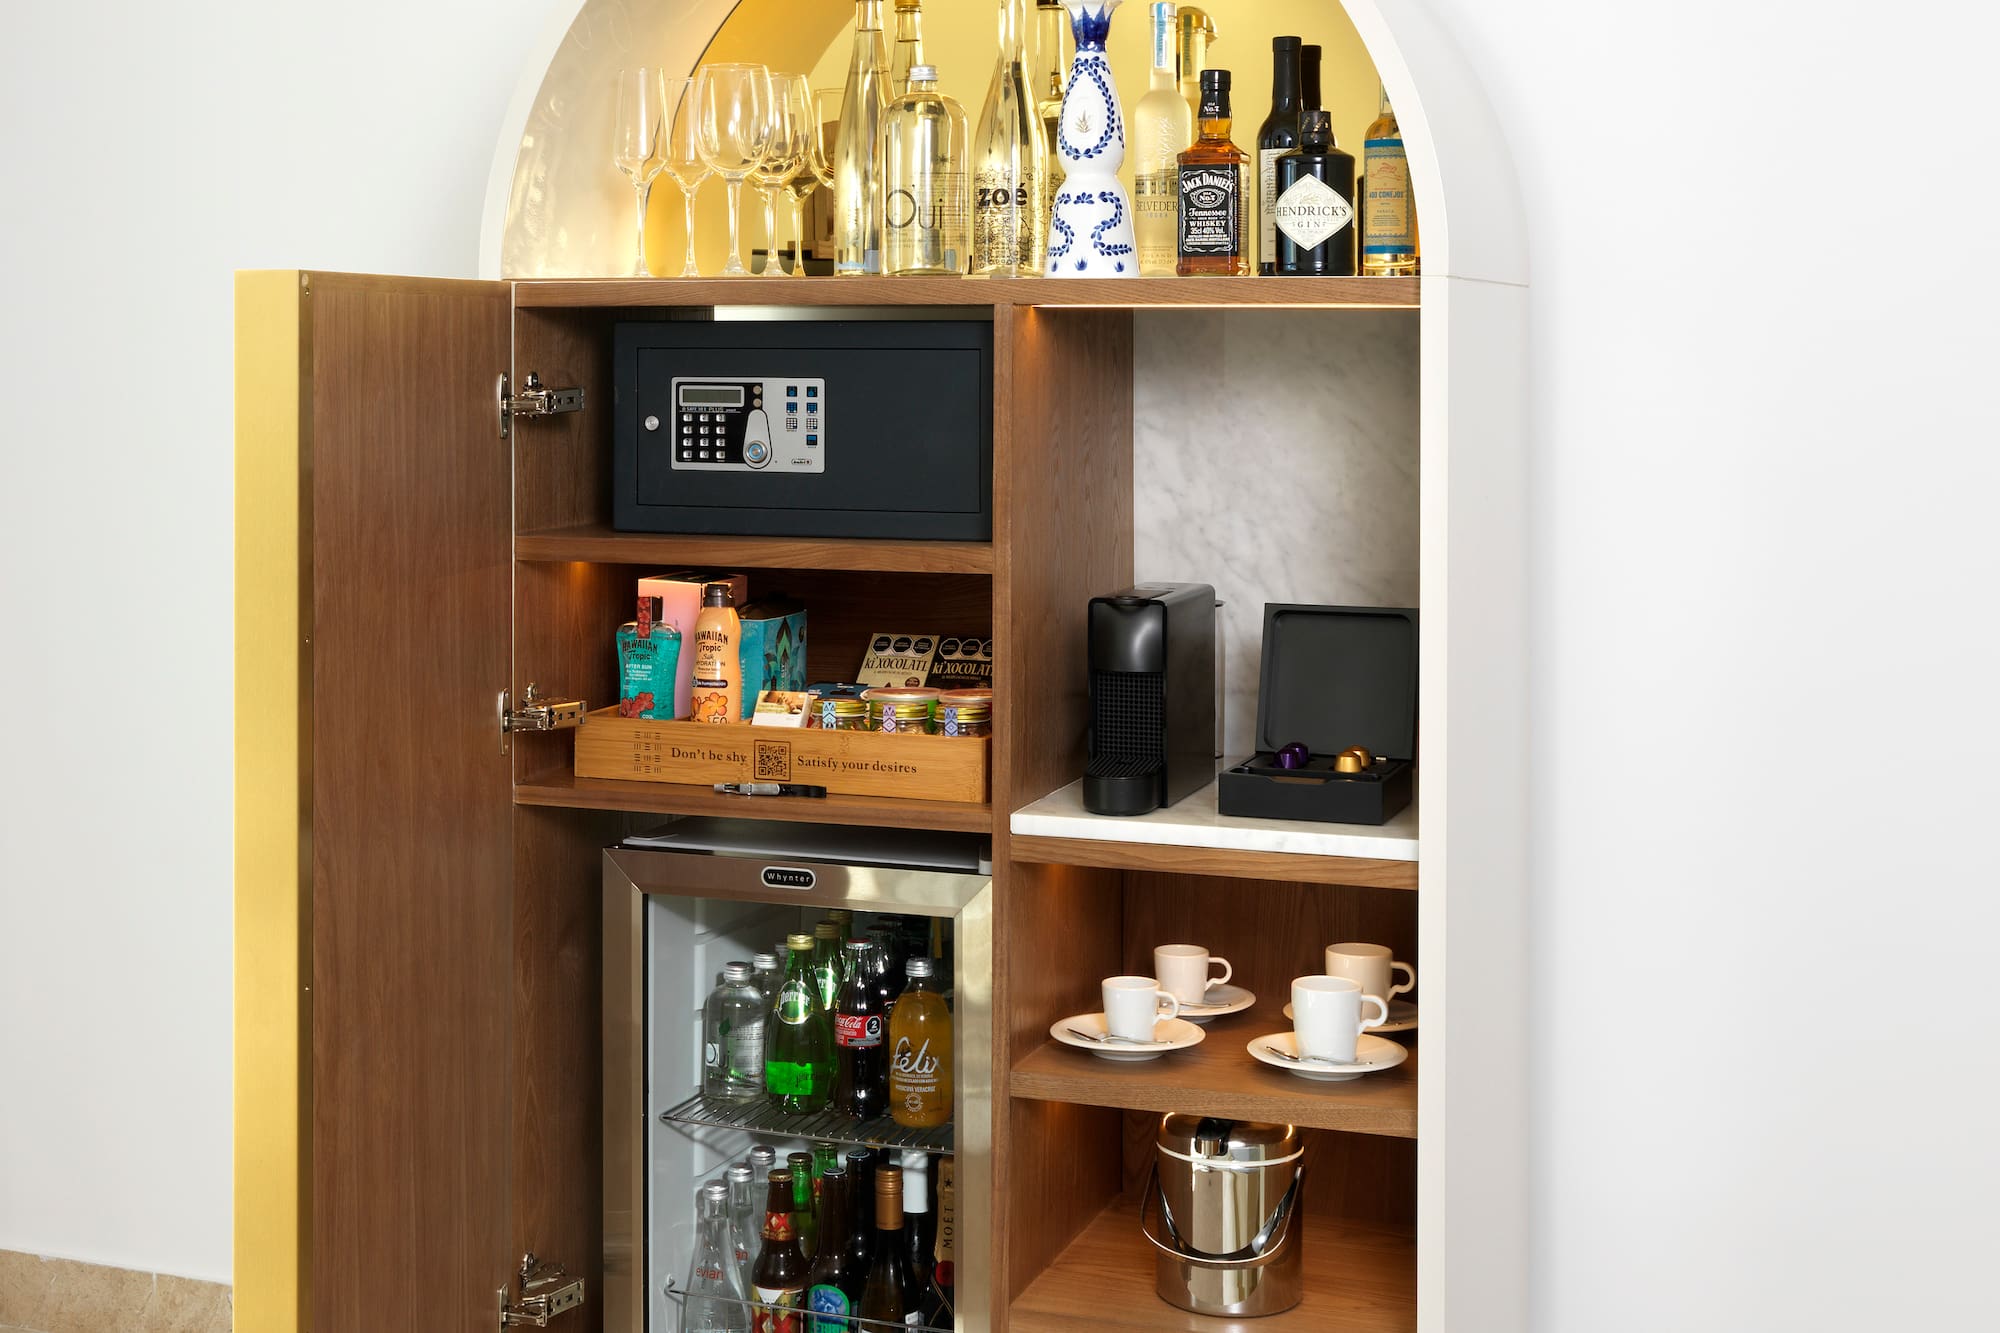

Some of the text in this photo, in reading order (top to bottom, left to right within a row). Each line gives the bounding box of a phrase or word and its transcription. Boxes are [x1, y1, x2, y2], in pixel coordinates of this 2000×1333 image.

[1182, 172, 1235, 193] JACK DANIEL'S
[979, 182, 1028, 207] zoé
[1136, 200, 1178, 212] BELVEDER
[1188, 207, 1227, 217] Tennessee
[1276, 205, 1347, 217] HENDRICK'S
[622, 640, 657, 654] HAWAIIAN
[699, 642, 721, 652] Tropic
[628, 650, 651, 661] Tropic
[931, 661, 992, 676] ki'XOCOLAT
[672, 748, 746, 765] Don't be shy
[797, 756, 917, 774] Satisfy your desires
[767, 873, 810, 883] Whynter
[871, 1020, 878, 1029] 2
[696, 1267, 724, 1281] evian
